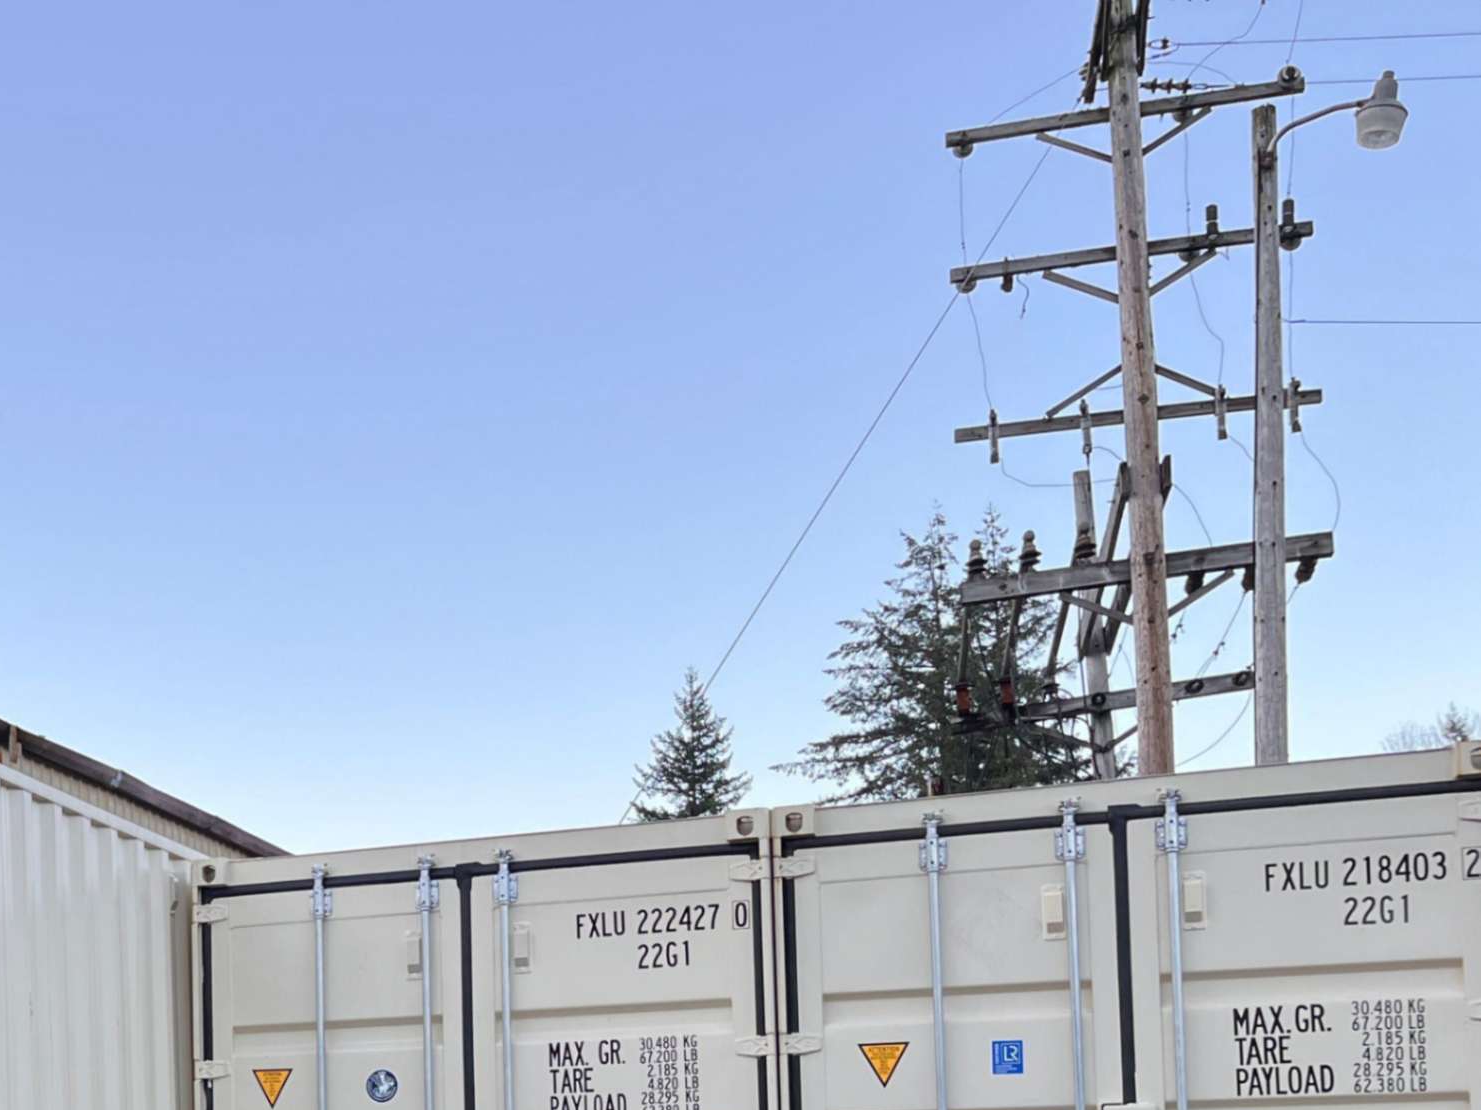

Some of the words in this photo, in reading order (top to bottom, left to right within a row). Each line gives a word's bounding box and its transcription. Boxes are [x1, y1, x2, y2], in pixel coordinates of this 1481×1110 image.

[1265, 860, 1329, 892] FXLU
[1342, 851, 1447, 886] 218403
[1466, 848, 1481, 878] 2
[1343, 894, 1409, 926] 22G1
[576, 910, 626, 939] FXLU
[637, 903, 720, 935] 222427
[735, 901, 748, 927] 0
[638, 940, 690, 969] 22G1
[1408, 998, 1426, 1014] KG
[1408, 1014, 1425, 1029] LB
[683, 1034, 698, 1048] KG
[1409, 1030, 1426, 1045] KG
[548, 1040, 589, 1067] MAX.
[598, 1039, 626, 1065] GR.
[683, 1049, 698, 1062] LB
[1234, 1035, 1292, 1066] TARE
[1409, 1045, 1426, 1061] LB
[684, 1062, 699, 1076] KG
[1410, 1061, 1427, 1076] KG
[549, 1067, 595, 1094] TARE
[685, 1076, 699, 1089] LB
[1236, 1064, 1335, 1097] PAYLOAD
[1410, 1077, 1427, 1092] LB
[685, 1090, 700, 1103] KG
